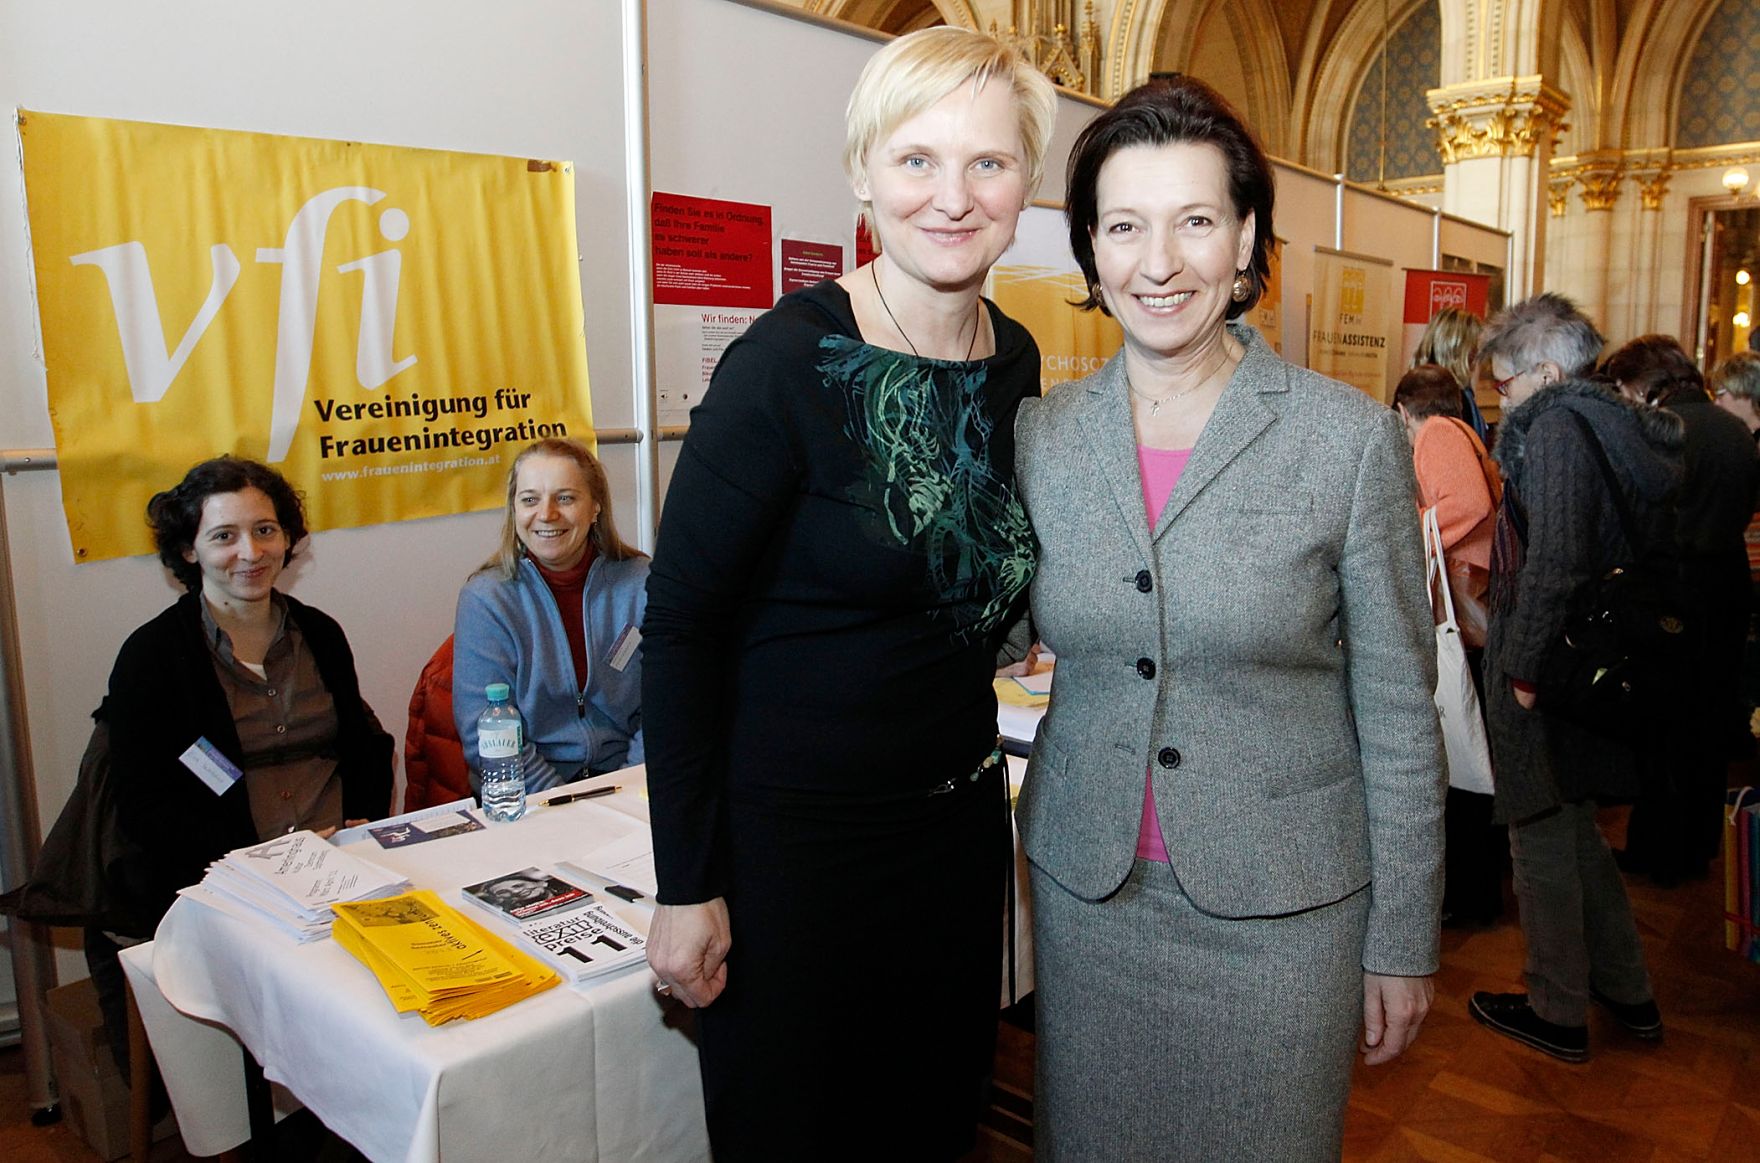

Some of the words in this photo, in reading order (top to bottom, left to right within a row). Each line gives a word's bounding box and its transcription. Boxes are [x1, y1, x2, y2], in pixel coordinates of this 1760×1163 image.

[654, 202, 685, 215] Finden
[687, 206, 701, 217] Sie
[704, 210, 714, 218] es
[716, 211, 724, 219] in
[694, 221, 725, 232] Familie
[668, 233, 709, 245] schwerer
[655, 246, 684, 257] haben
[687, 248, 702, 258] soll
[704, 249, 717, 259] als
[719, 251, 752, 262] andere?
[68, 186, 418, 463] vfi
[701, 313, 716, 323] Wir
[718, 314, 747, 324] finden:
[1313, 330, 1386, 348] FRAUENASSISTENZ
[314, 393, 488, 422] Vereinigung
[494, 388, 531, 410] für
[320, 419, 567, 458] Frauenintegration
[321, 455, 500, 481] www.frauenintegration.at
[523, 916, 581, 937] literatur
[544, 928, 603, 952] preise
